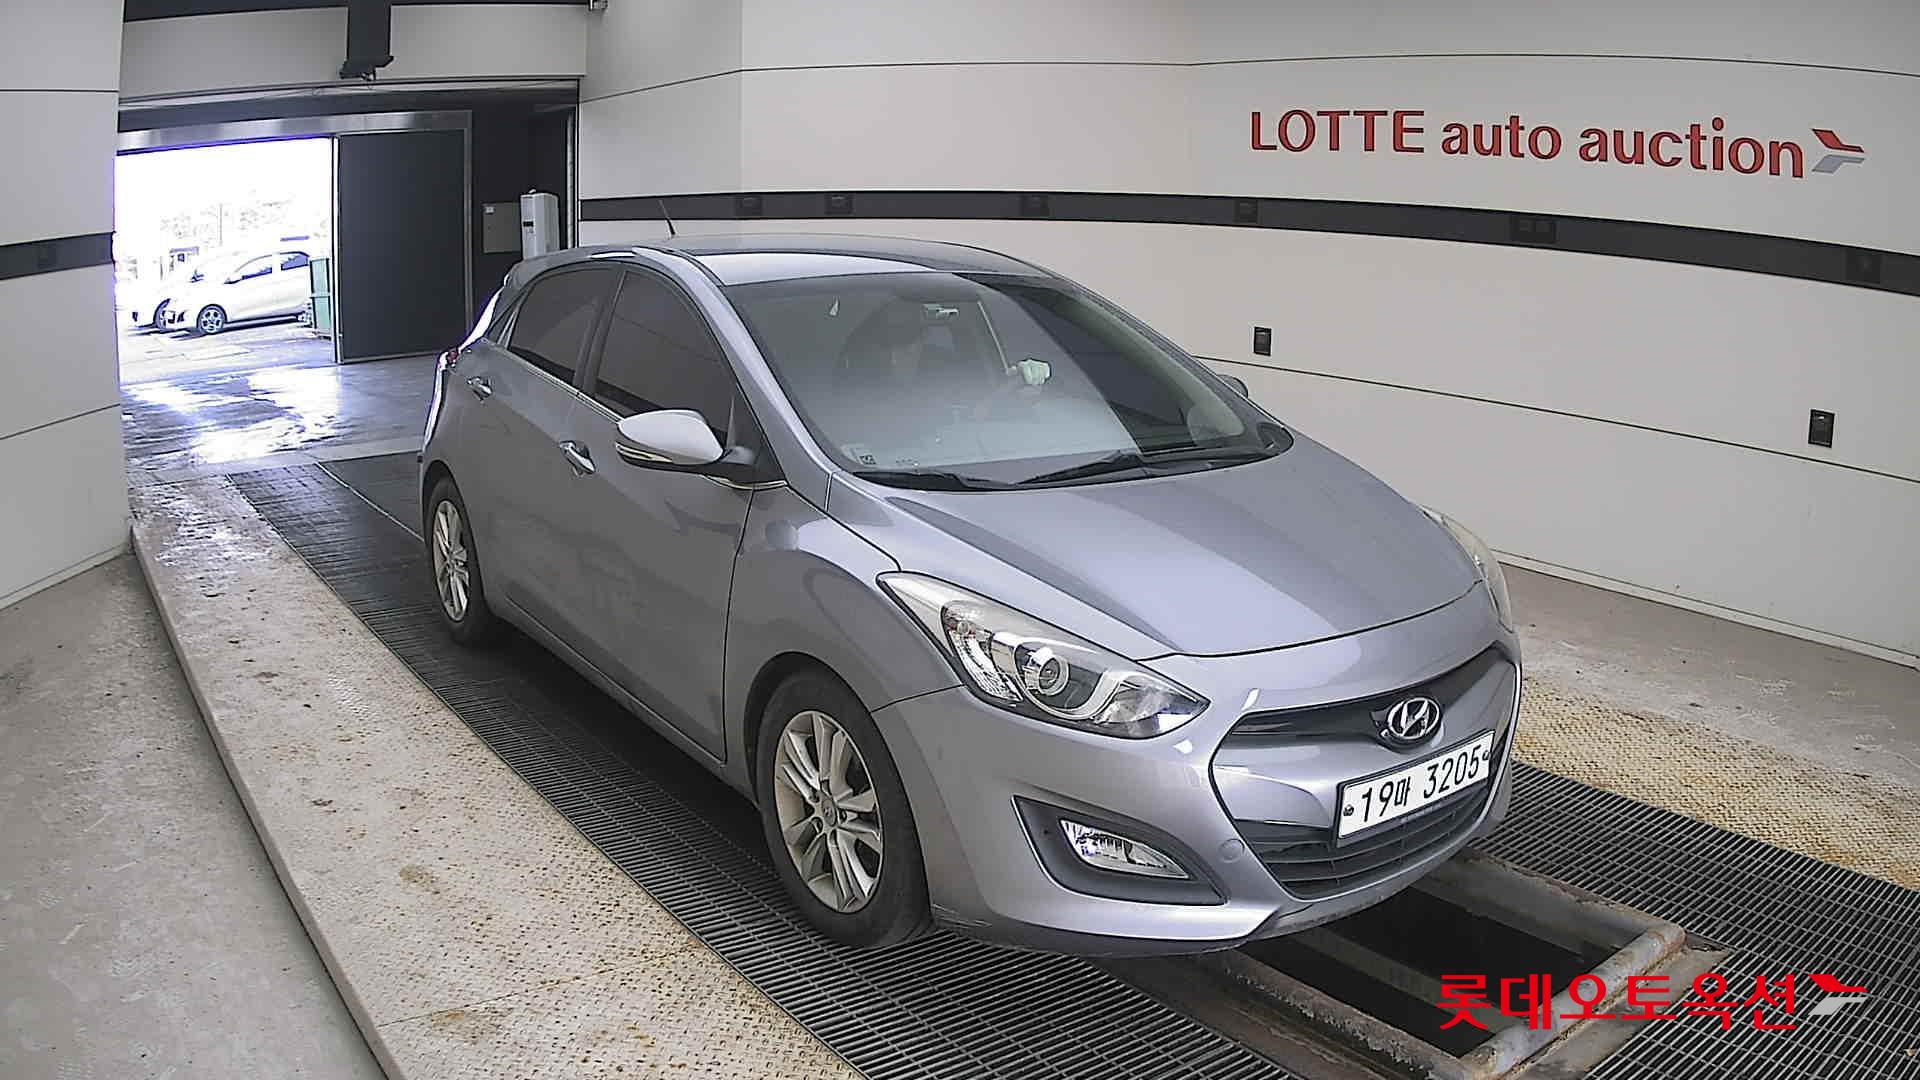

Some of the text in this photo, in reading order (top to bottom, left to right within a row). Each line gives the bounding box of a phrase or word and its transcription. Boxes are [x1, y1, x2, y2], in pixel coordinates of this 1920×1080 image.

[1250, 110, 1805, 179] LOTTE auto auction
[1361, 744, 1483, 823] 19마 3205
